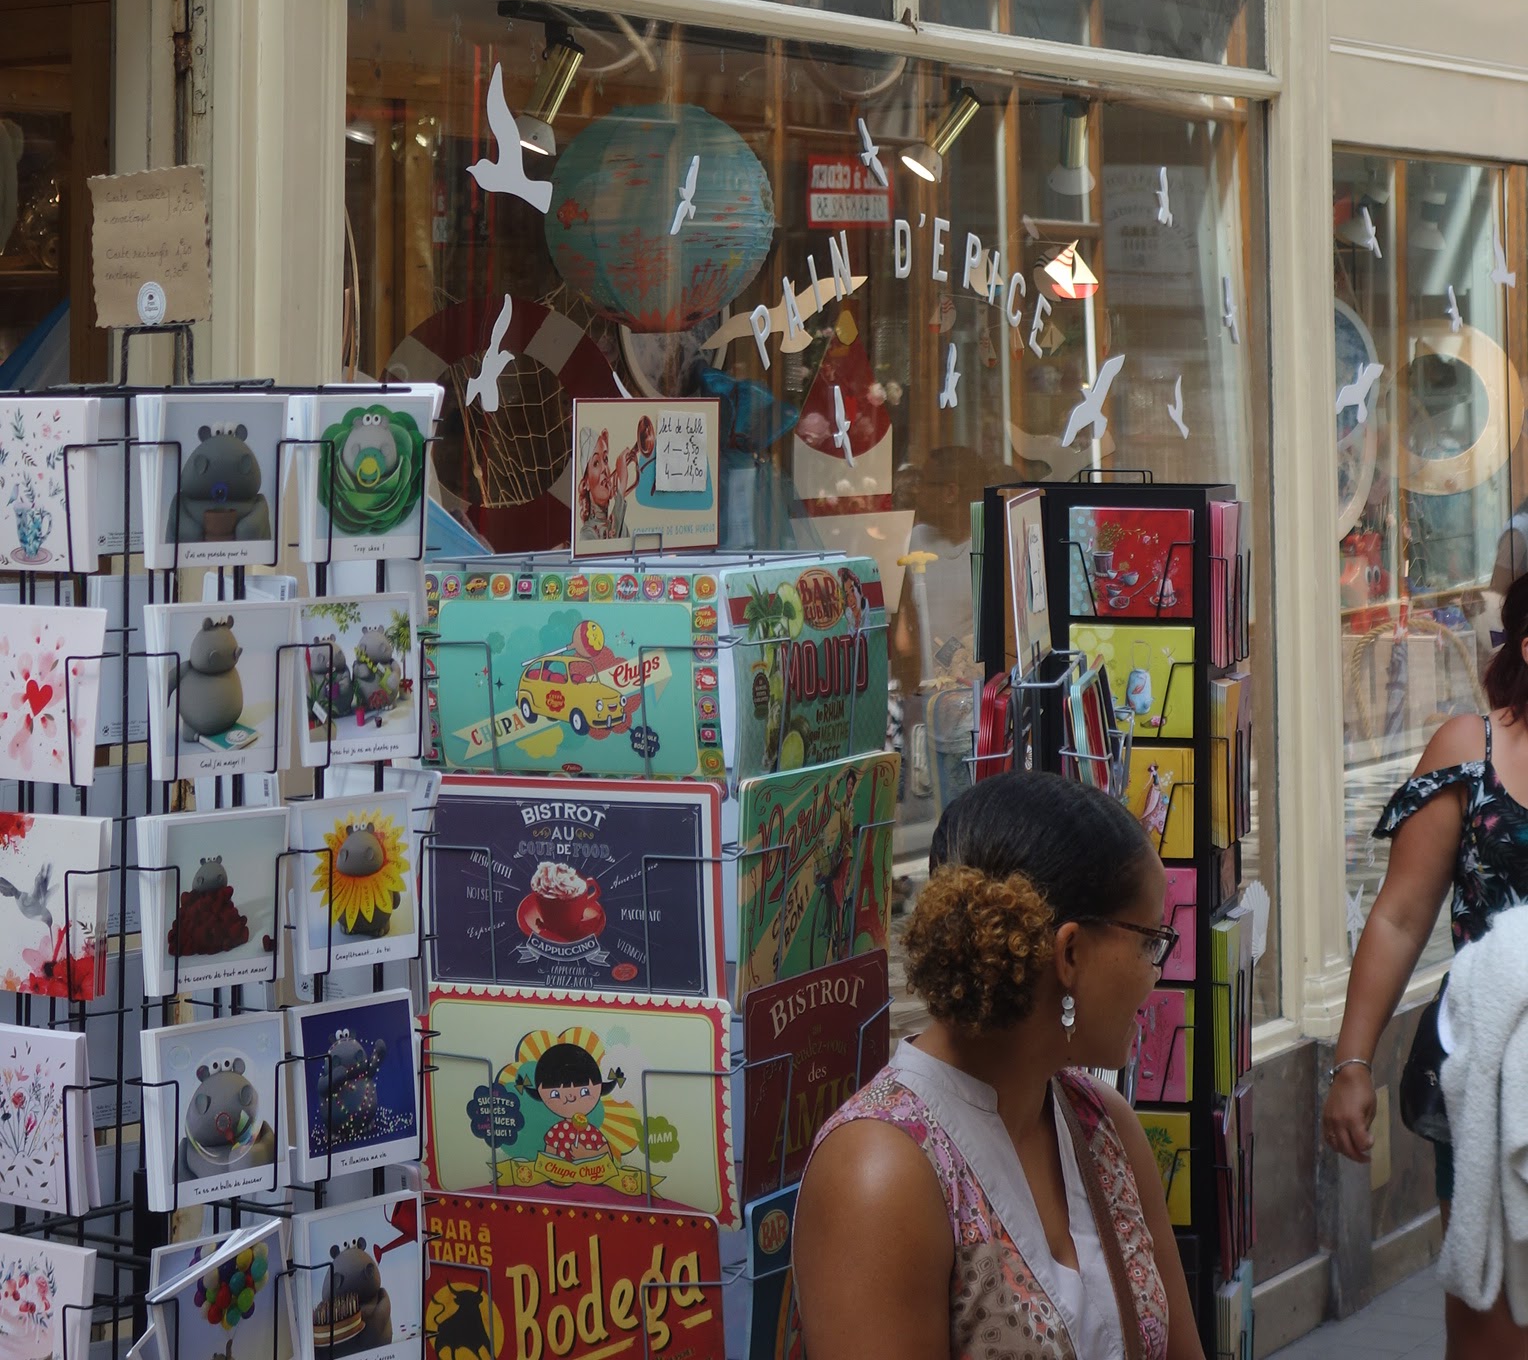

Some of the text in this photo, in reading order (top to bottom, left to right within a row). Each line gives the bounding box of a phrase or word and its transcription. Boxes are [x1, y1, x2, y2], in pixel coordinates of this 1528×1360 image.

[749, 230, 854, 371] PAIN
[894, 212, 1053, 359] D'EPICE
[675, 418, 682, 434] de
[686, 417, 703, 434] table
[799, 576, 838, 605] BAR
[611, 655, 661, 688] Chups
[781, 633, 869, 706] MOJITO
[471, 713, 525, 746] CHUPA
[521, 802, 607, 828] BISTROT
[552, 826, 575, 840] AU
[518, 840, 610, 859] COUP DE FOOD
[758, 781, 832, 926] Paris
[530, 938, 596, 957] CAPPUCCINO
[214, 971, 221, 979] de
[223, 968, 236, 978] tout
[768, 977, 865, 1040] BISTROT
[807, 1062, 827, 1083] des
[486, 1129, 507, 1137] SUCI
[544, 1161, 606, 1182] Chupa Chups
[430, 1217, 472, 1241] BAR
[761, 1214, 787, 1249] BAR
[431, 1240, 493, 1267] TAPAS
[546, 1222, 581, 1295] la
[506, 1234, 706, 1360] Bodega
